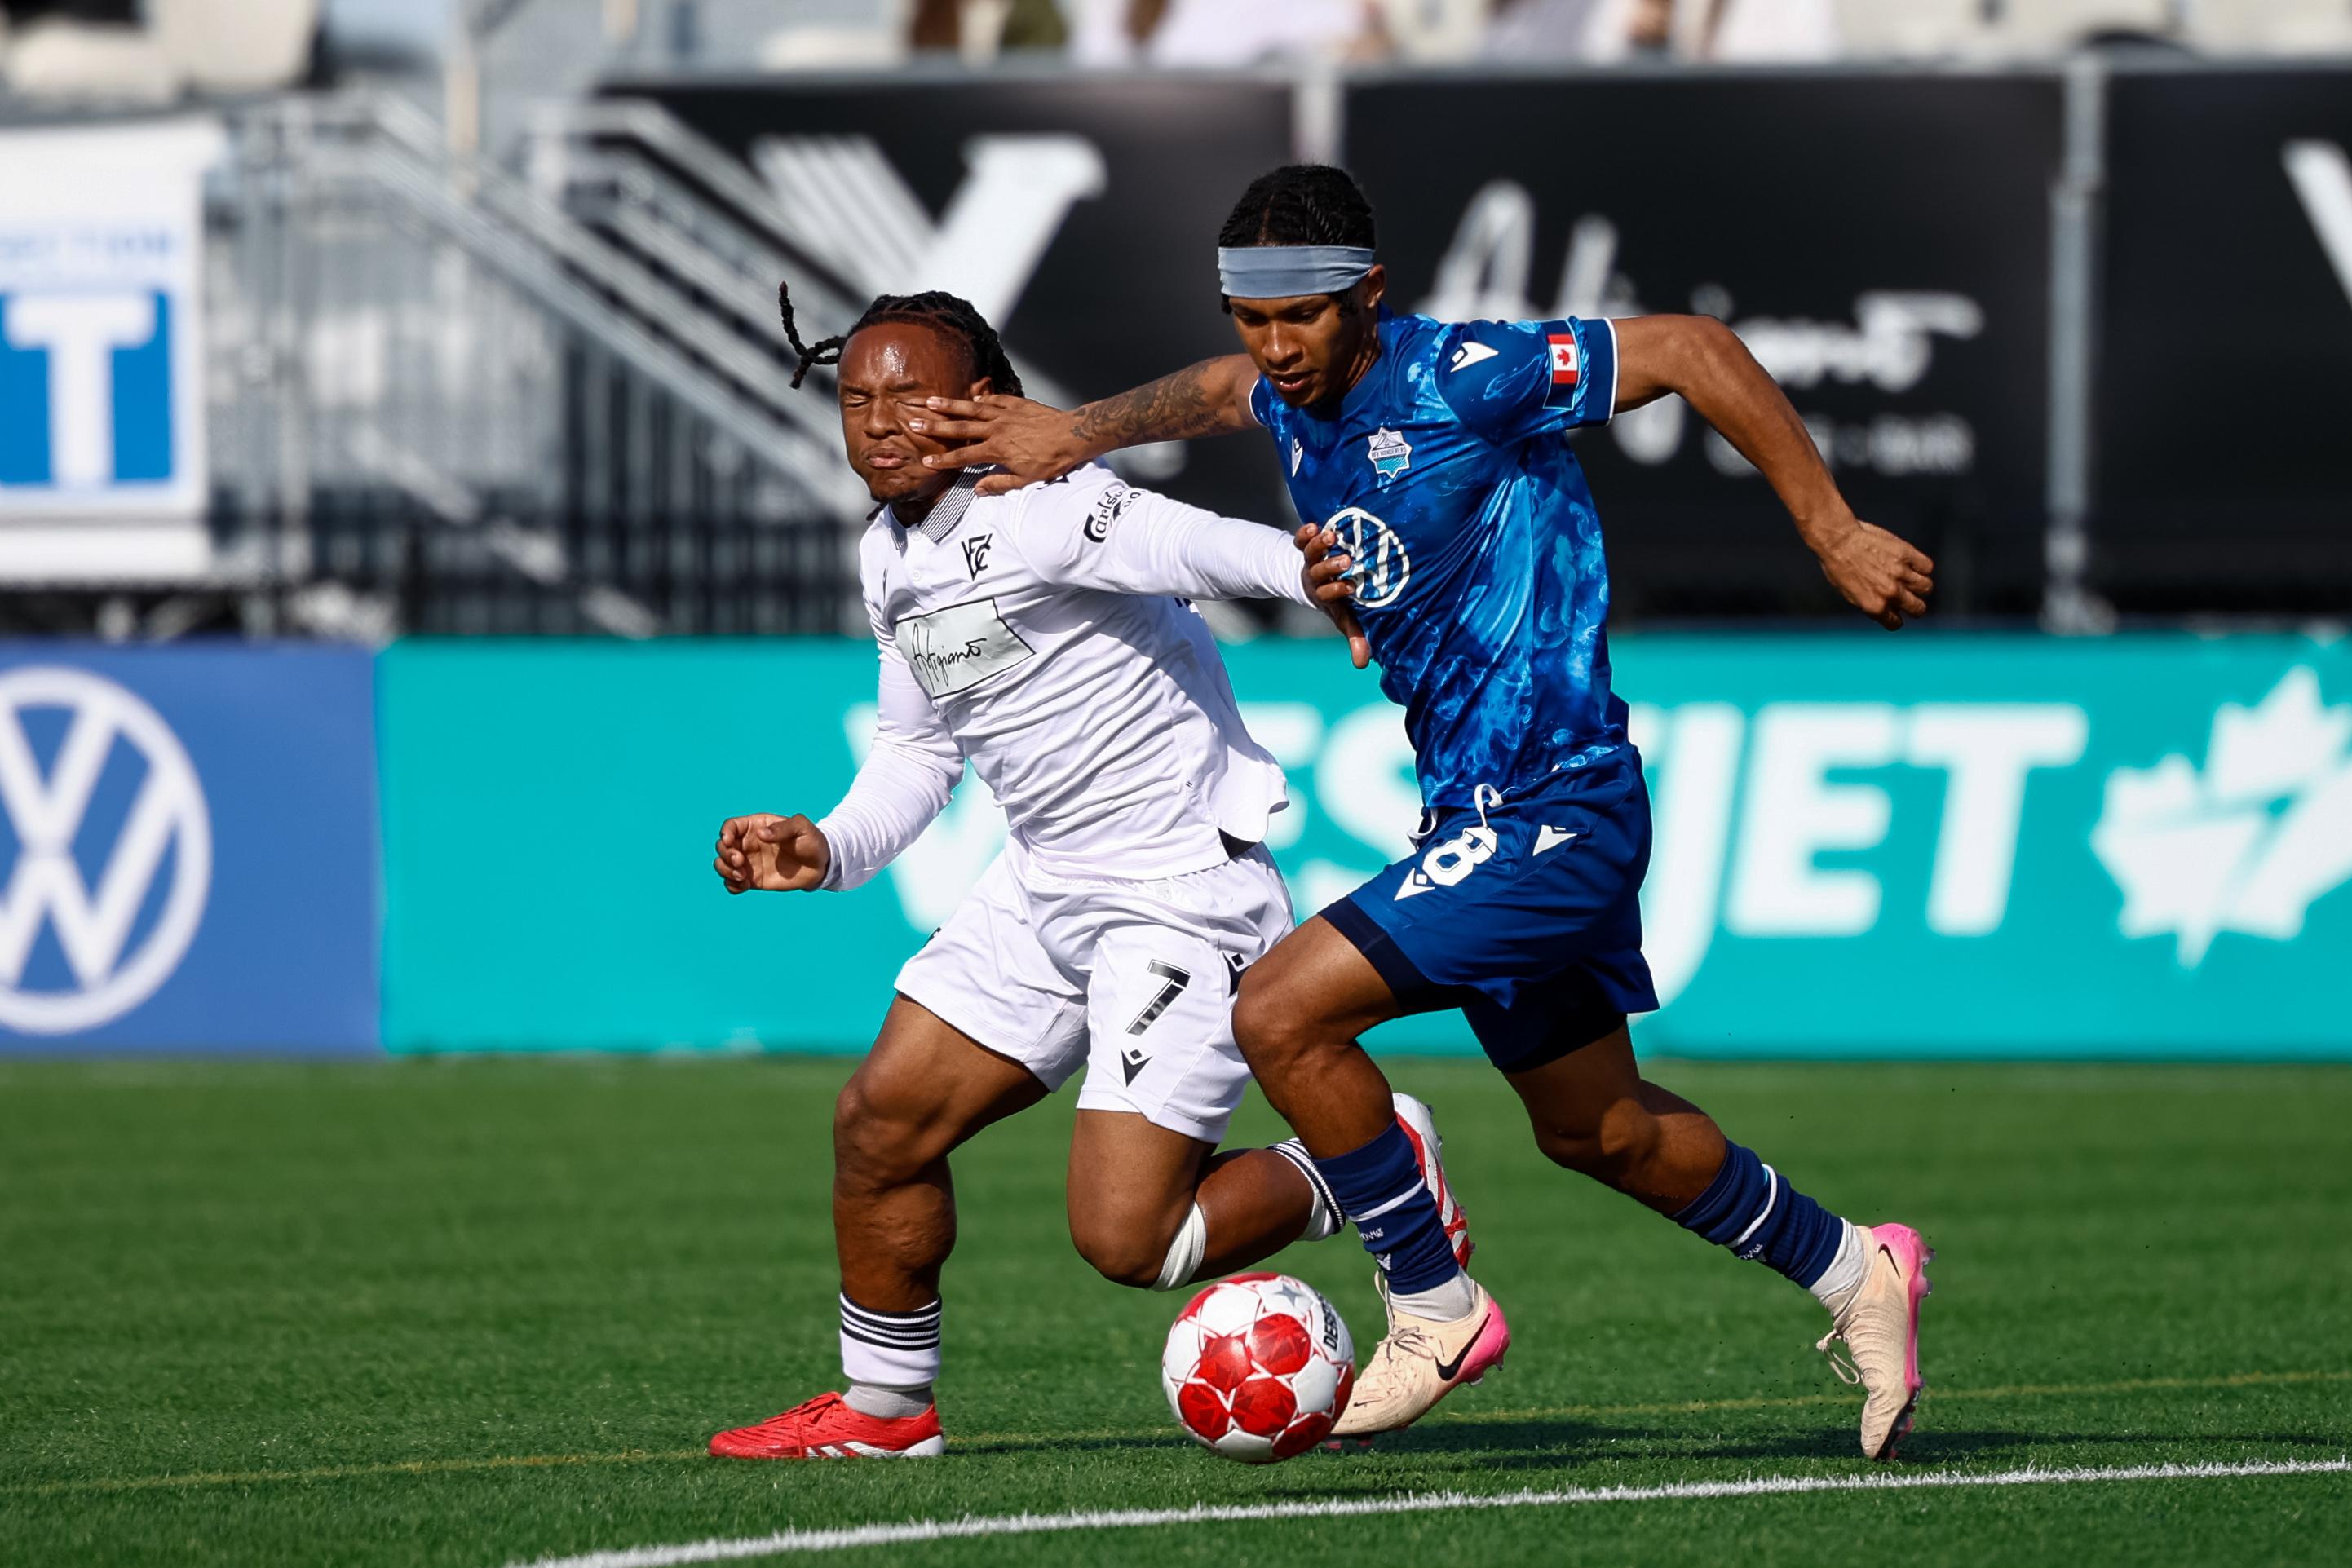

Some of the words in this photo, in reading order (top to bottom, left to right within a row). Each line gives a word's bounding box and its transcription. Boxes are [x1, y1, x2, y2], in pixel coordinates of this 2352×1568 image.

[7, 293, 157, 487] T
[1421, 827, 1497, 886] 8
[1125, 959, 1191, 1036] 7
